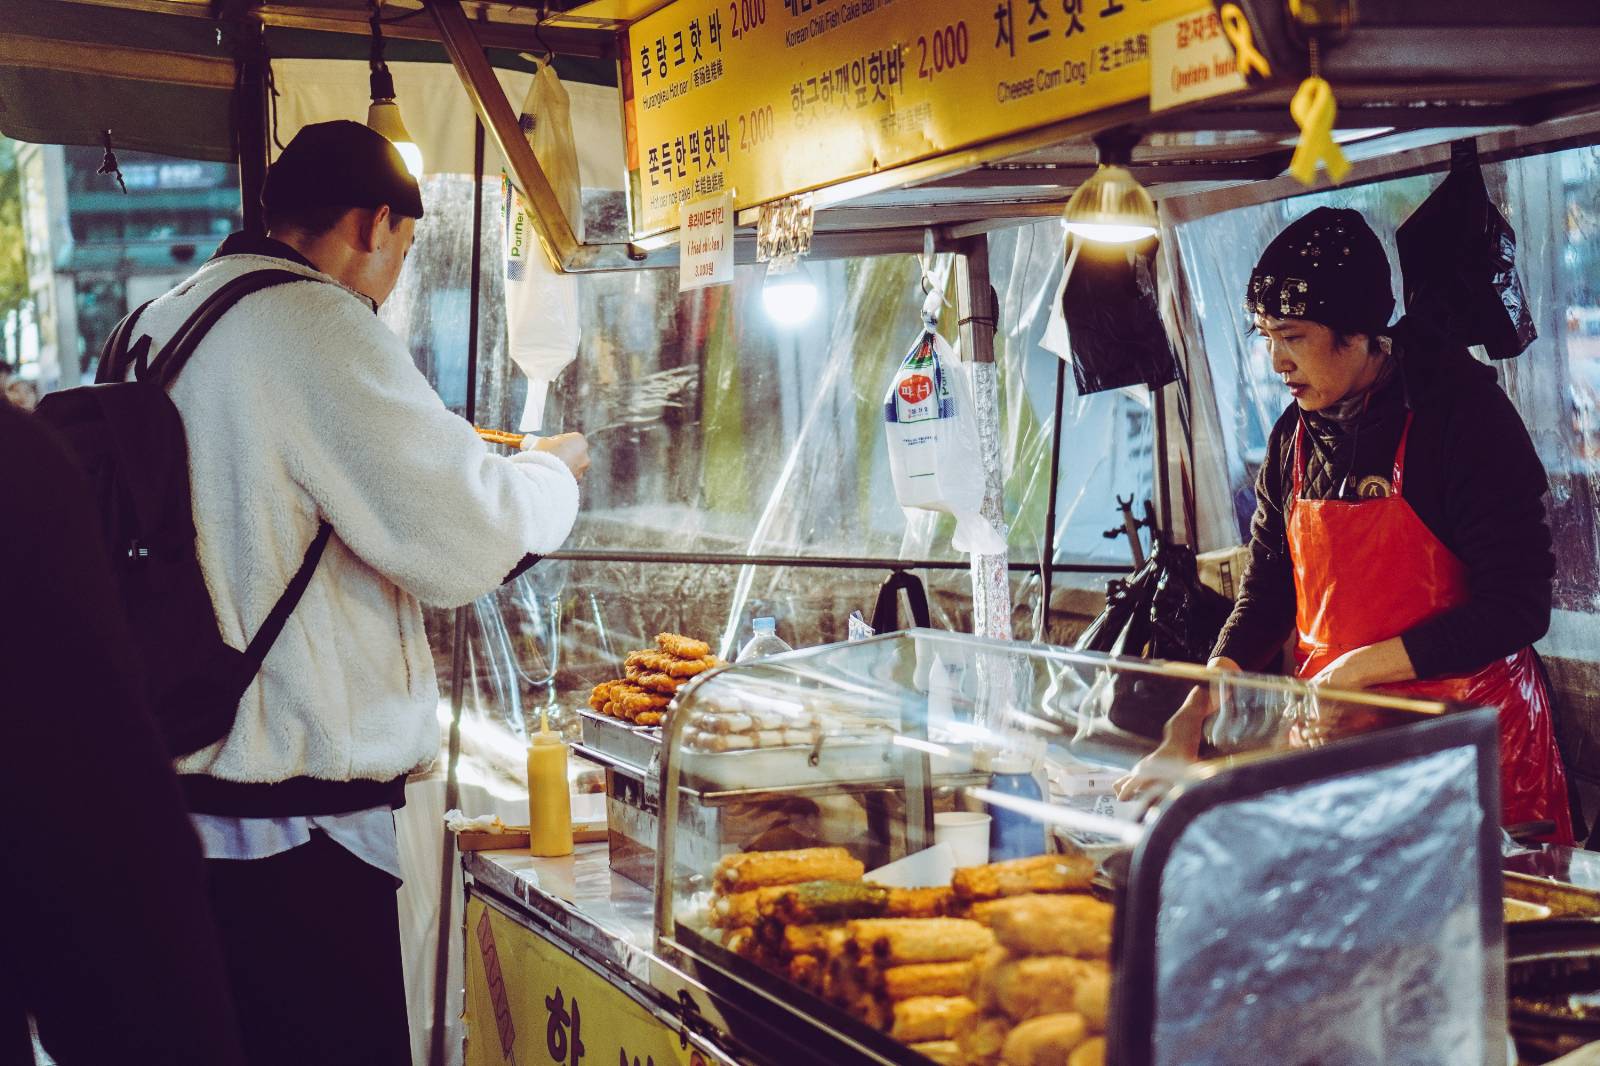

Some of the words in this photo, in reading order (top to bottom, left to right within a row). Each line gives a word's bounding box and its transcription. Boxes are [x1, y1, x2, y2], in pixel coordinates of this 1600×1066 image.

[640, 9, 722, 86] 후랑크핫바
[730, 0, 766, 40] 2,000
[786, 27, 809, 48] Korean
[825, 10, 840, 31] Fish
[841, 3, 860, 24] Cake
[791, 43, 904, 128] 향긋한깻잎핫바
[917, 21, 968, 81] 2,000
[997, 77, 1035, 104] Cheese
[1063, 60, 1086, 85] Dog
[648, 120, 730, 186] 쫀득한떡핫바
[739, 105, 774, 151] 2,000
[511, 211, 524, 257] Partner
[688, 206, 724, 231] 후라이드치킨
